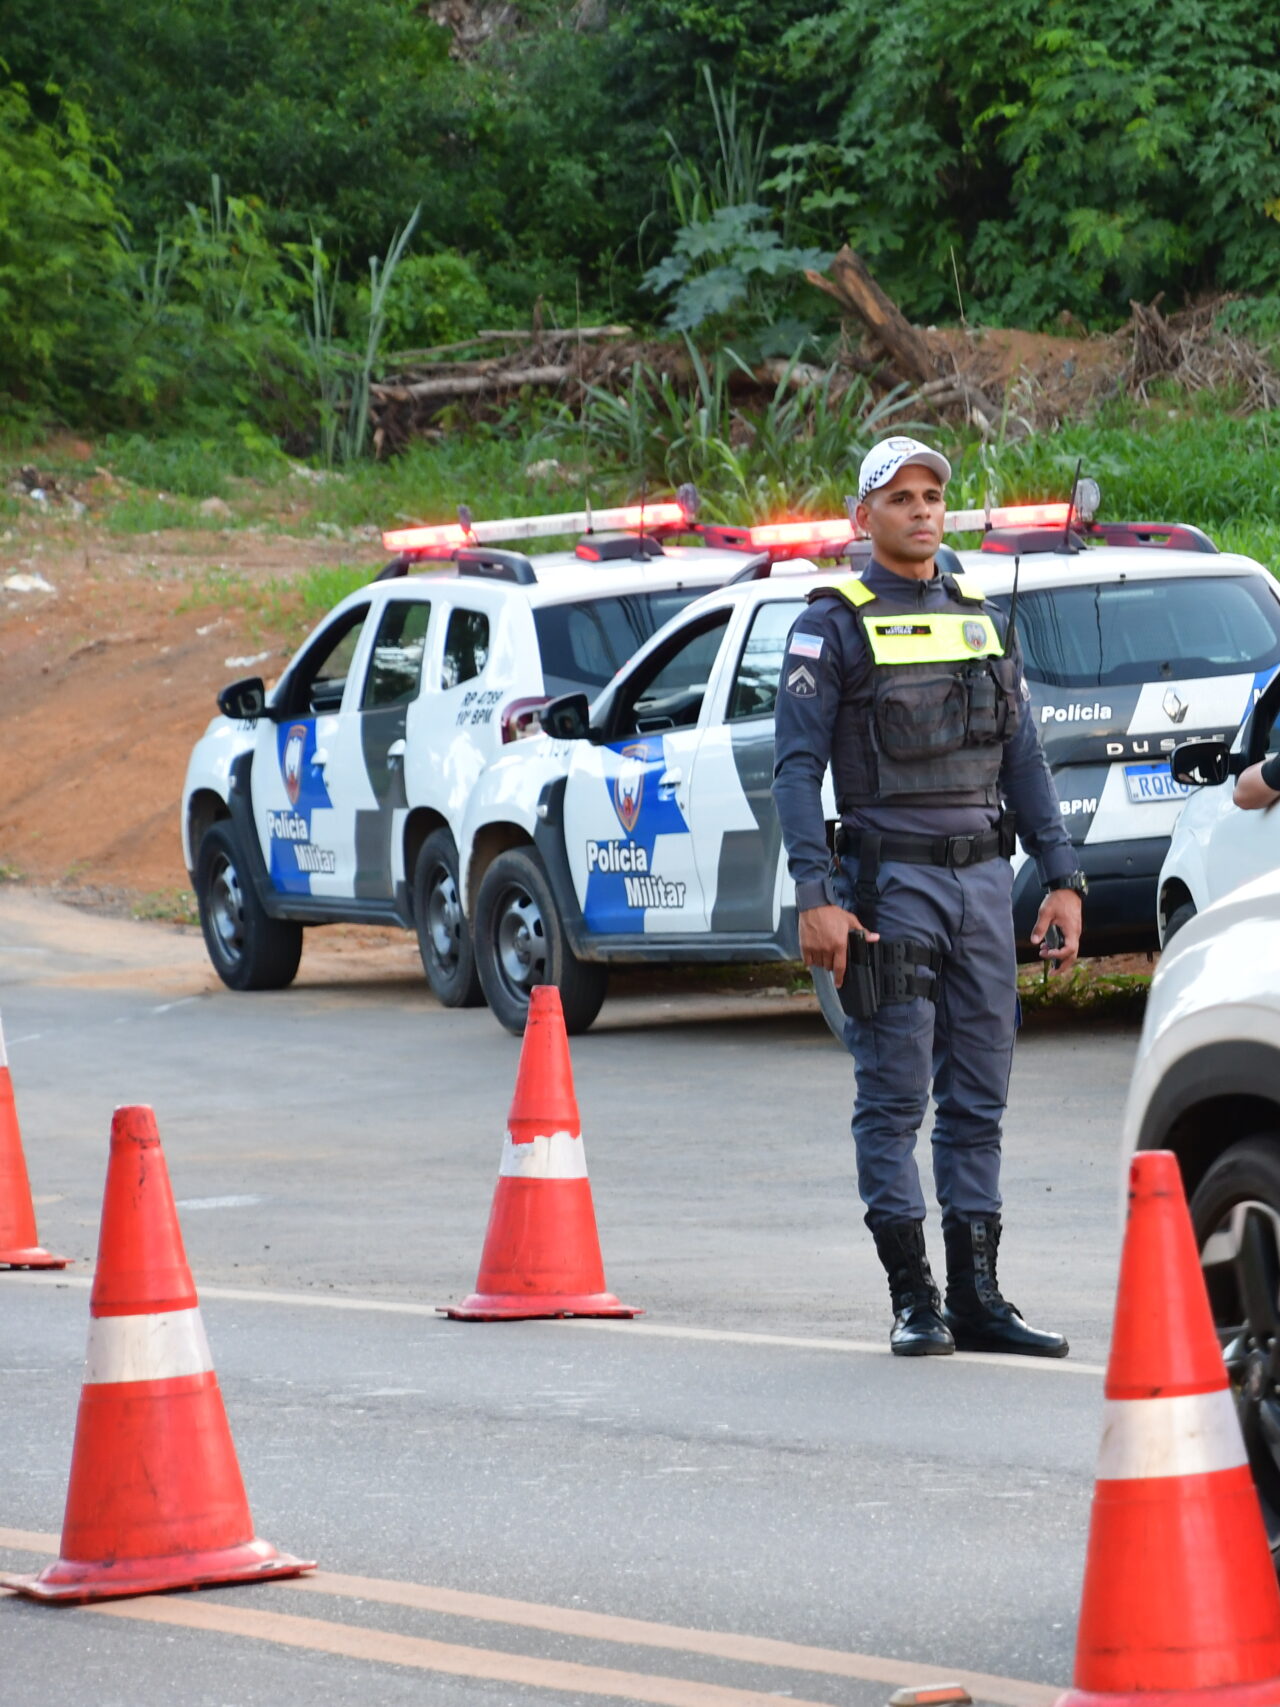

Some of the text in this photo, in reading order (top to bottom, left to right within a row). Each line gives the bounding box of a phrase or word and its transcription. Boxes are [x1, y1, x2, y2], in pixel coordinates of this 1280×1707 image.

[1040, 703, 1112, 723] Polícia
[1059, 798, 1097, 815] BPM
[293, 844, 335, 874] Militar
[586, 839, 648, 873] Polícia
[624, 875, 686, 908] Militar
